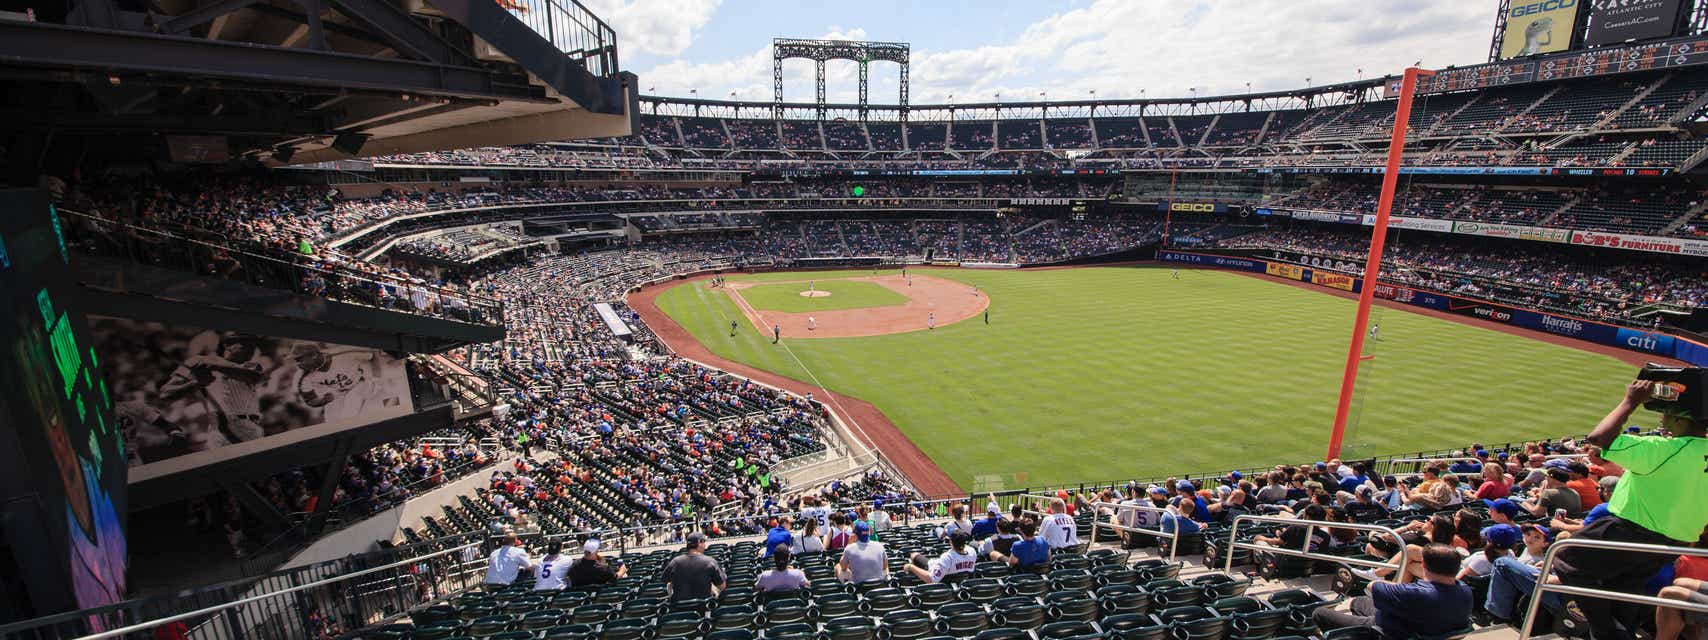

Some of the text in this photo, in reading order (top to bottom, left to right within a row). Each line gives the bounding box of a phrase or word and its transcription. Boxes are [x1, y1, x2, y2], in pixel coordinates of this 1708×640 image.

[1511, 0, 1575, 17] GEICO
[1607, 5, 1642, 15] ATLANTIC
[1171, 203, 1215, 212] GEICO
[1621, 240, 1681, 253] FURNITURE
[1174, 254, 1201, 262] DELTA
[1375, 284, 1394, 296] ALUTE
[1474, 307, 1511, 321] verizon
[1542, 315, 1583, 331] Harrah's
[1627, 335, 1657, 350] citi
[1137, 511, 1147, 525] 5
[1062, 527, 1071, 543] 7
[541, 564, 552, 579] 5
